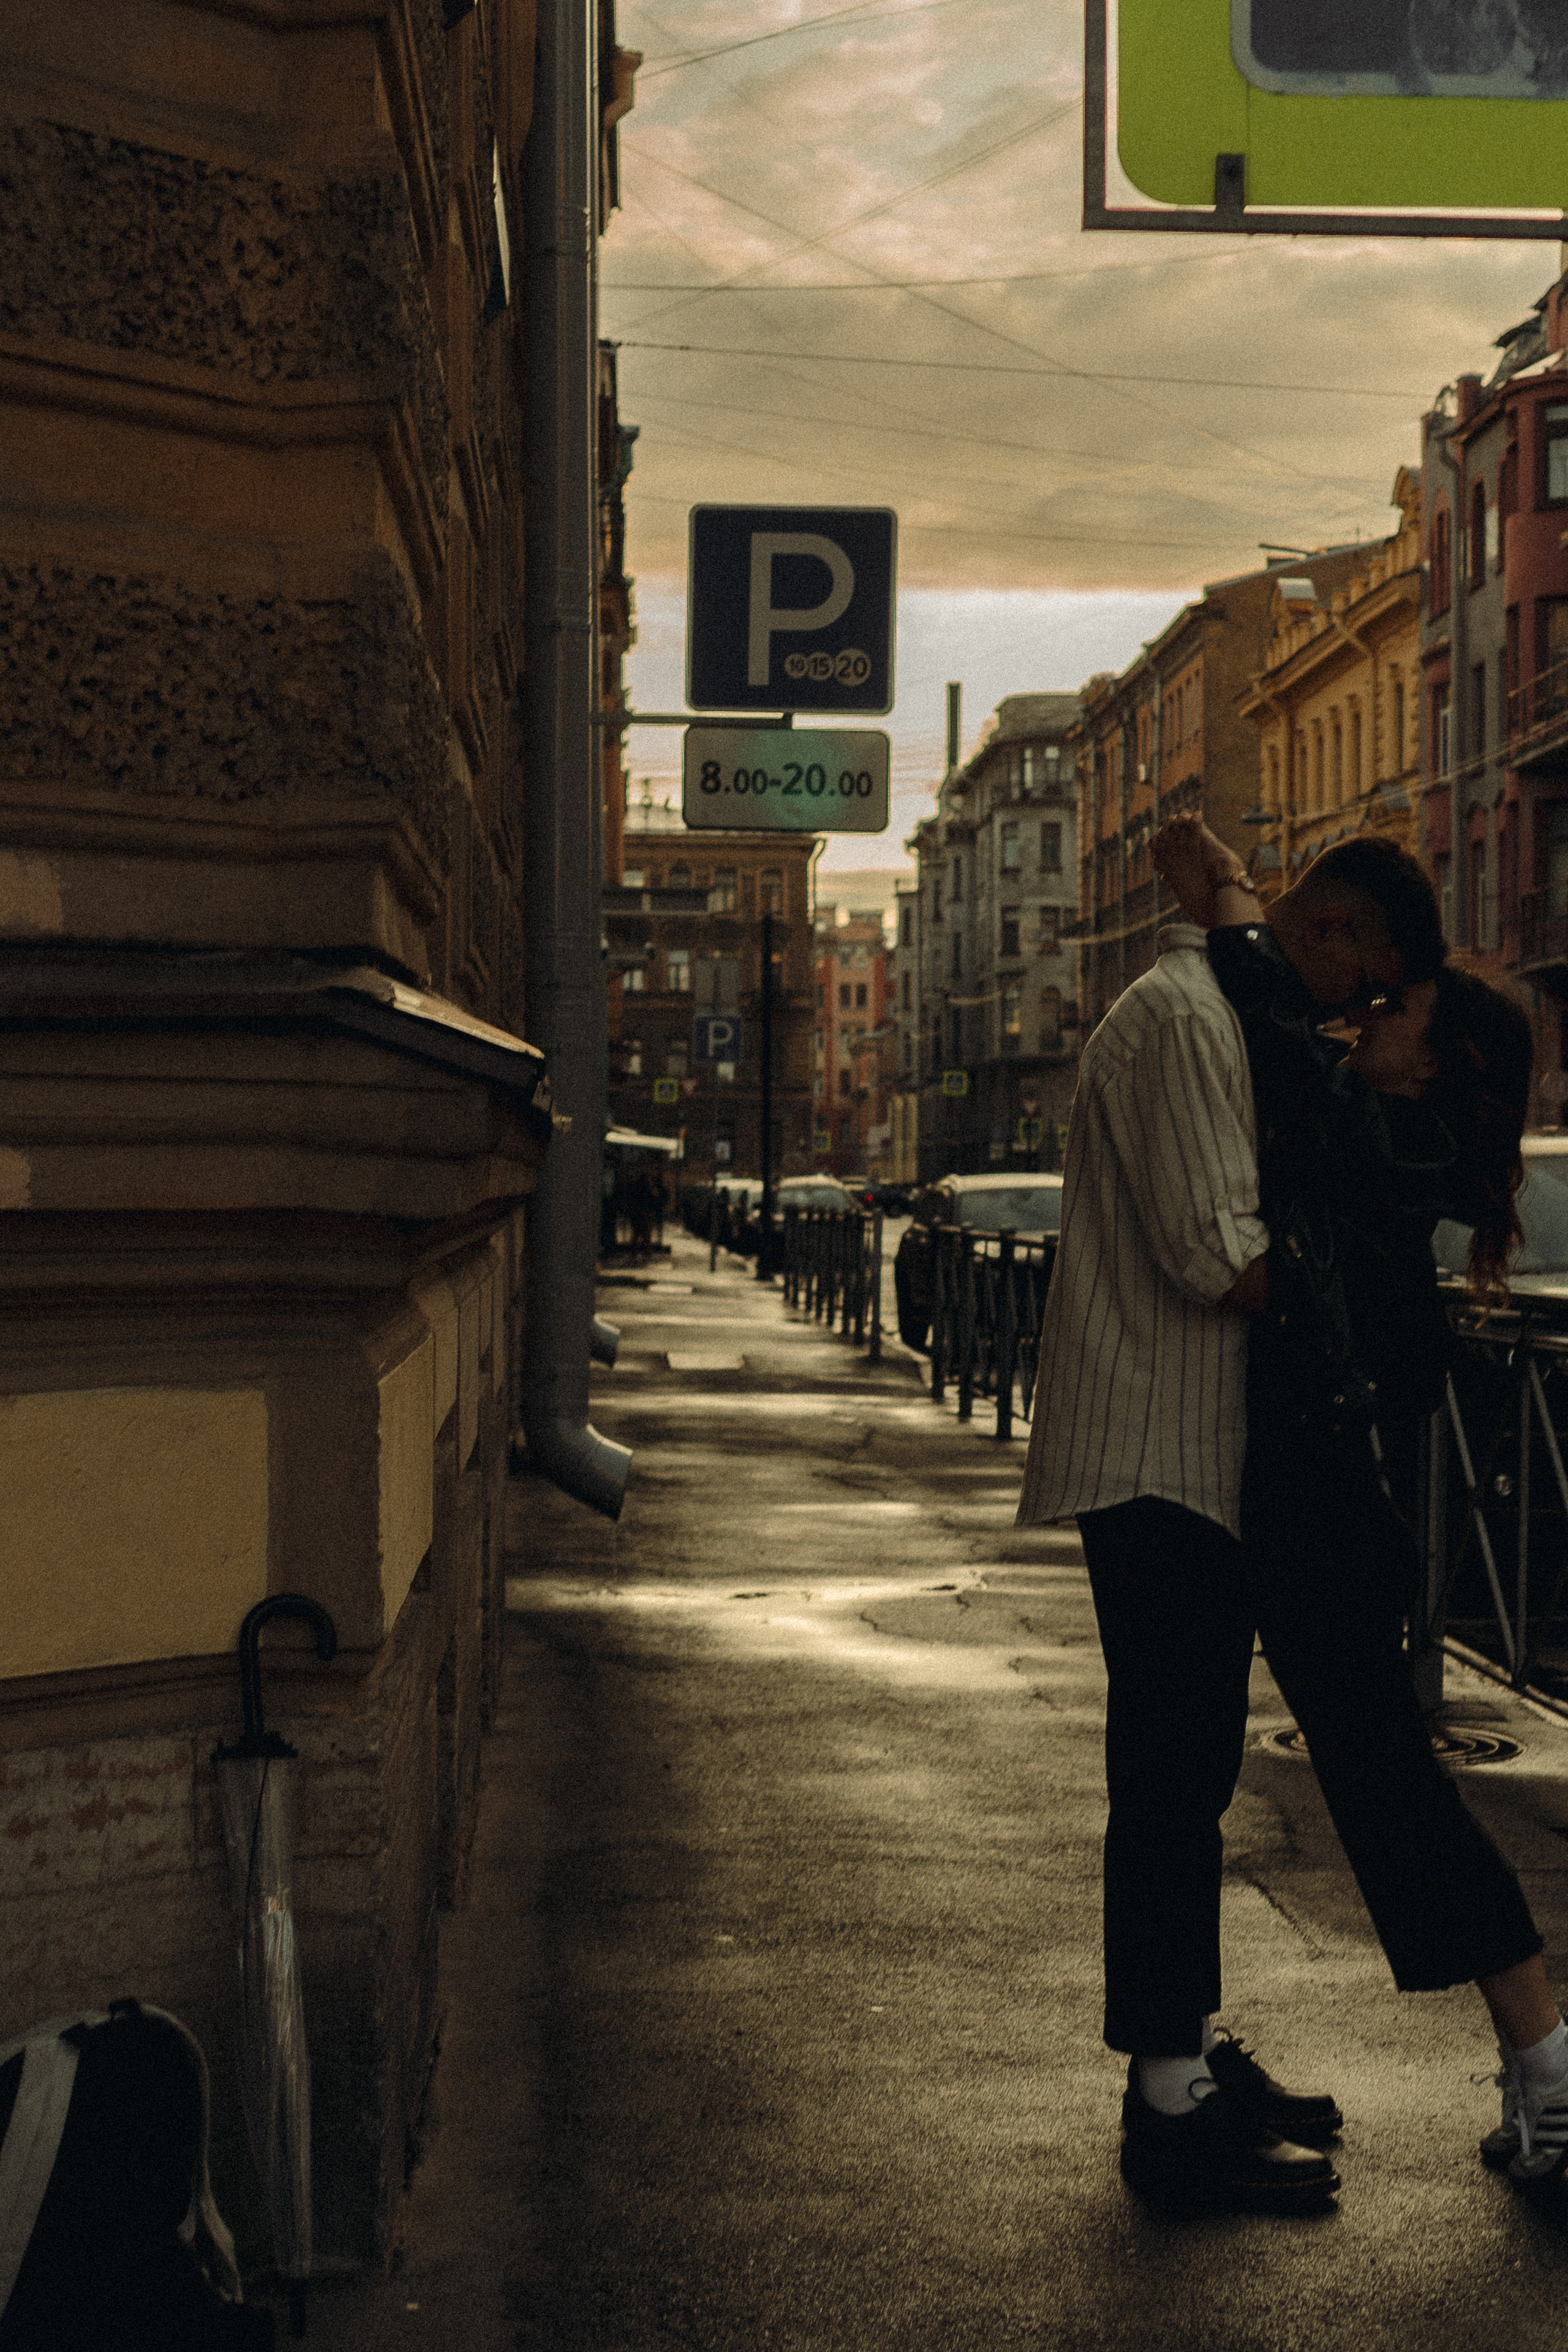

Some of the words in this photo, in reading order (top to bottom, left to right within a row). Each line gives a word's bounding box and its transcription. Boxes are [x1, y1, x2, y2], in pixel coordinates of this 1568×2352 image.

[748, 532, 854, 686] P
[790, 658, 806, 673] 10
[810, 657, 829, 676] 15
[838, 657, 868, 678] 20
[700, 760, 873, 798] 8.00-20.00
[708, 1020, 733, 1057] P
